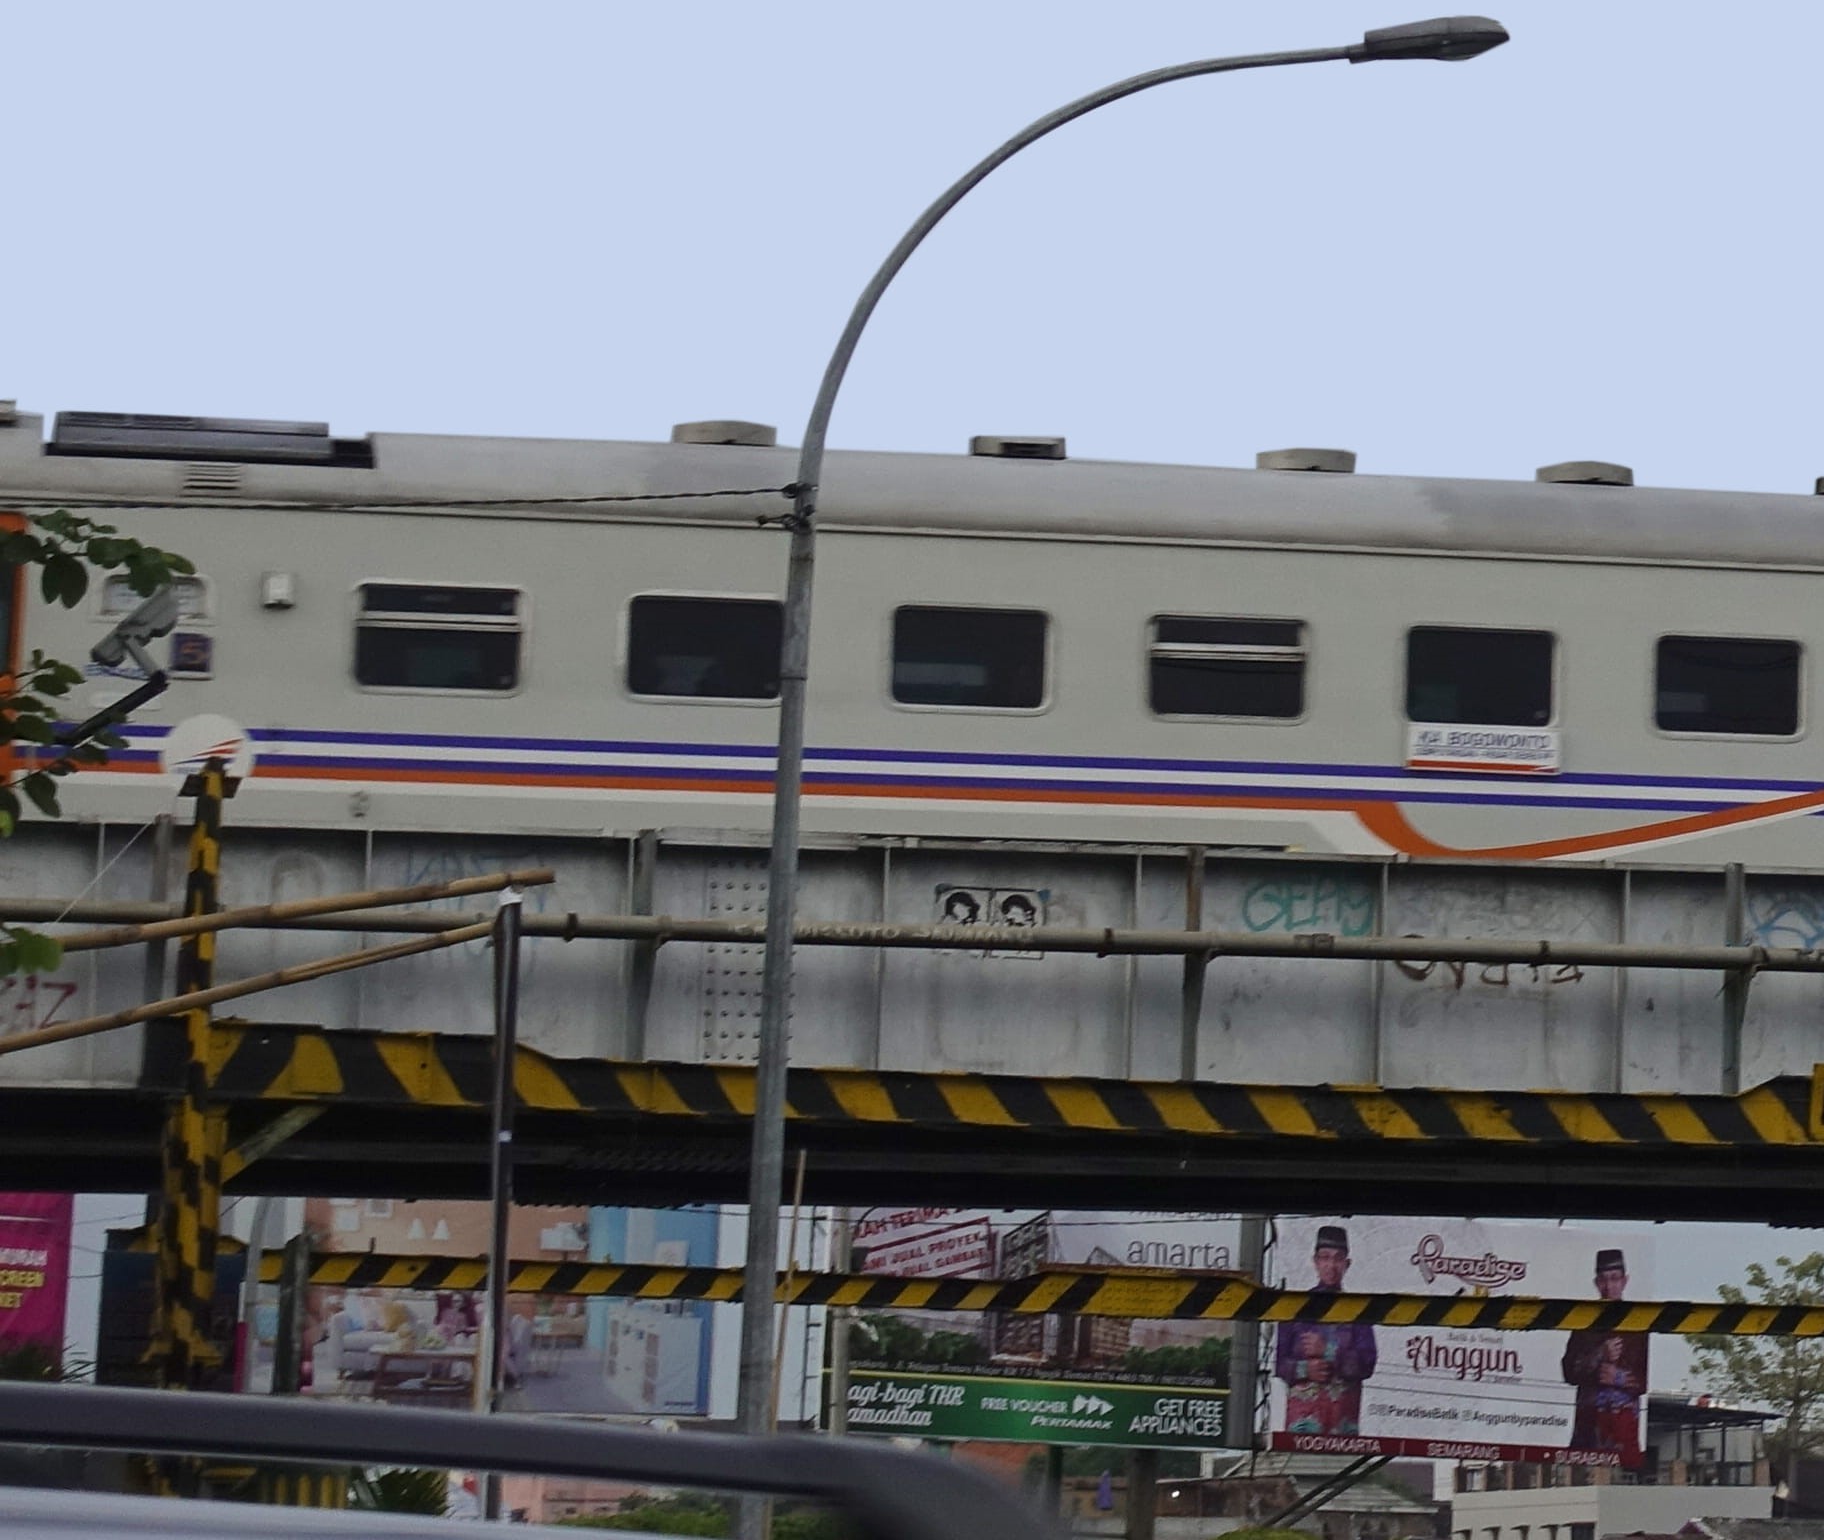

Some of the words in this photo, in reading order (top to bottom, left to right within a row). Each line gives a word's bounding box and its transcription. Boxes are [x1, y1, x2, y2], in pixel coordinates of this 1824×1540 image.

[1127, 1240, 1231, 1269] amarta
[1411, 1234, 1526, 1287] Paradise
[1406, 1335, 1523, 1382] Anggun
[848, 1381, 928, 1409] agi-bagi
[981, 1397, 1009, 1411] FREE
[1010, 1399, 1068, 1414] VOUCHER
[847, 1404, 933, 1427] amadhan
[1153, 1398, 1188, 1417] GET
[1188, 1400, 1225, 1418] FREE
[1128, 1415, 1223, 1437] APPLIANCES
[1293, 1435, 1381, 1454] YOGYAKARTA
[1427, 1442, 1500, 1461] SEMARANG
[1554, 1449, 1622, 1468] SURABAYA
